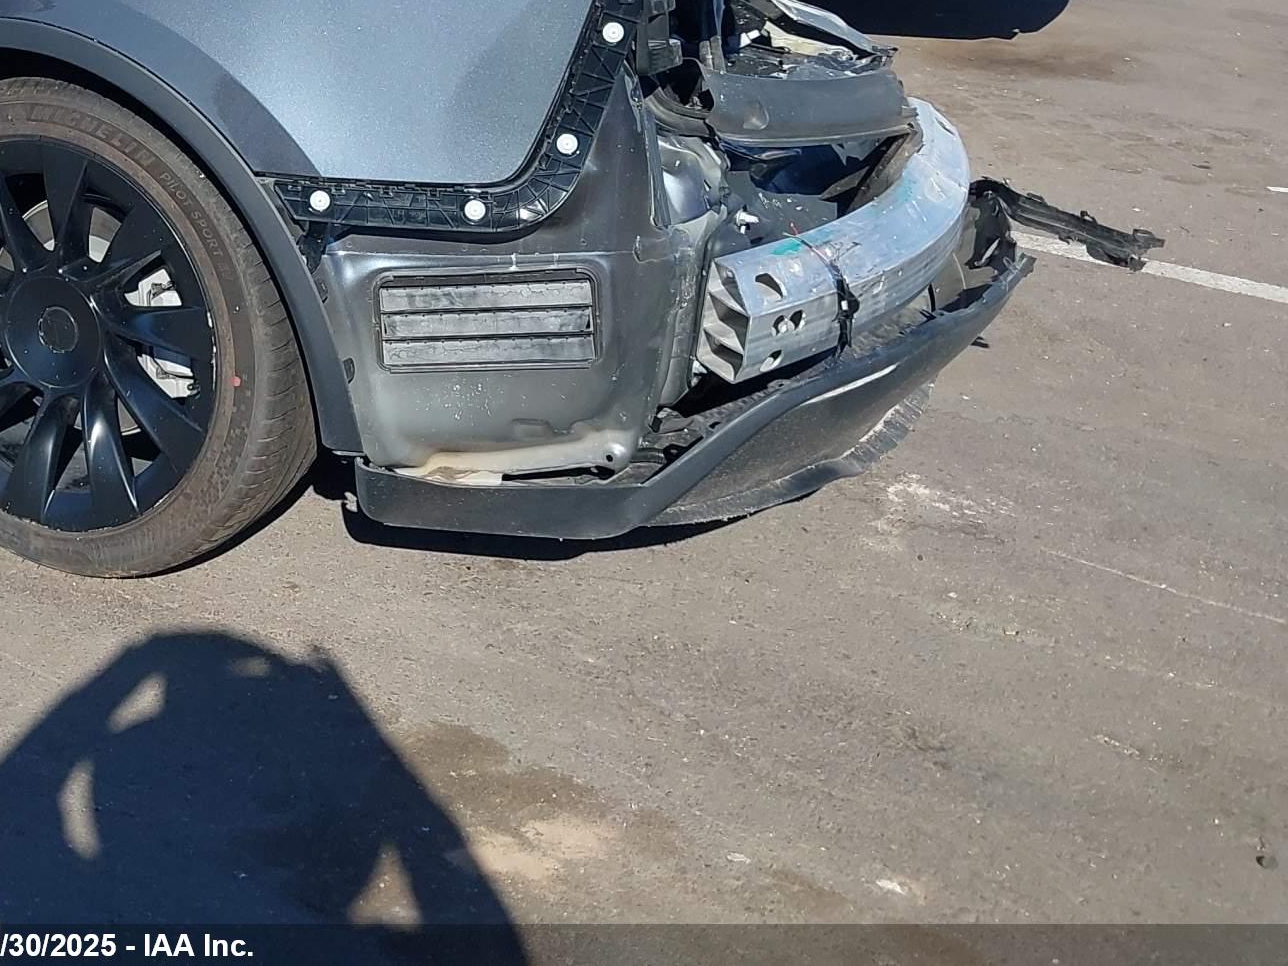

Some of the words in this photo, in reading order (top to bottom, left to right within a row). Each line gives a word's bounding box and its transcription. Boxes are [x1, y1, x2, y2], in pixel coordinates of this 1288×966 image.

[29, 105, 157, 168] MICHELIN
[159, 172, 192, 206] PILOT
[191, 210, 223, 256] SPORT
